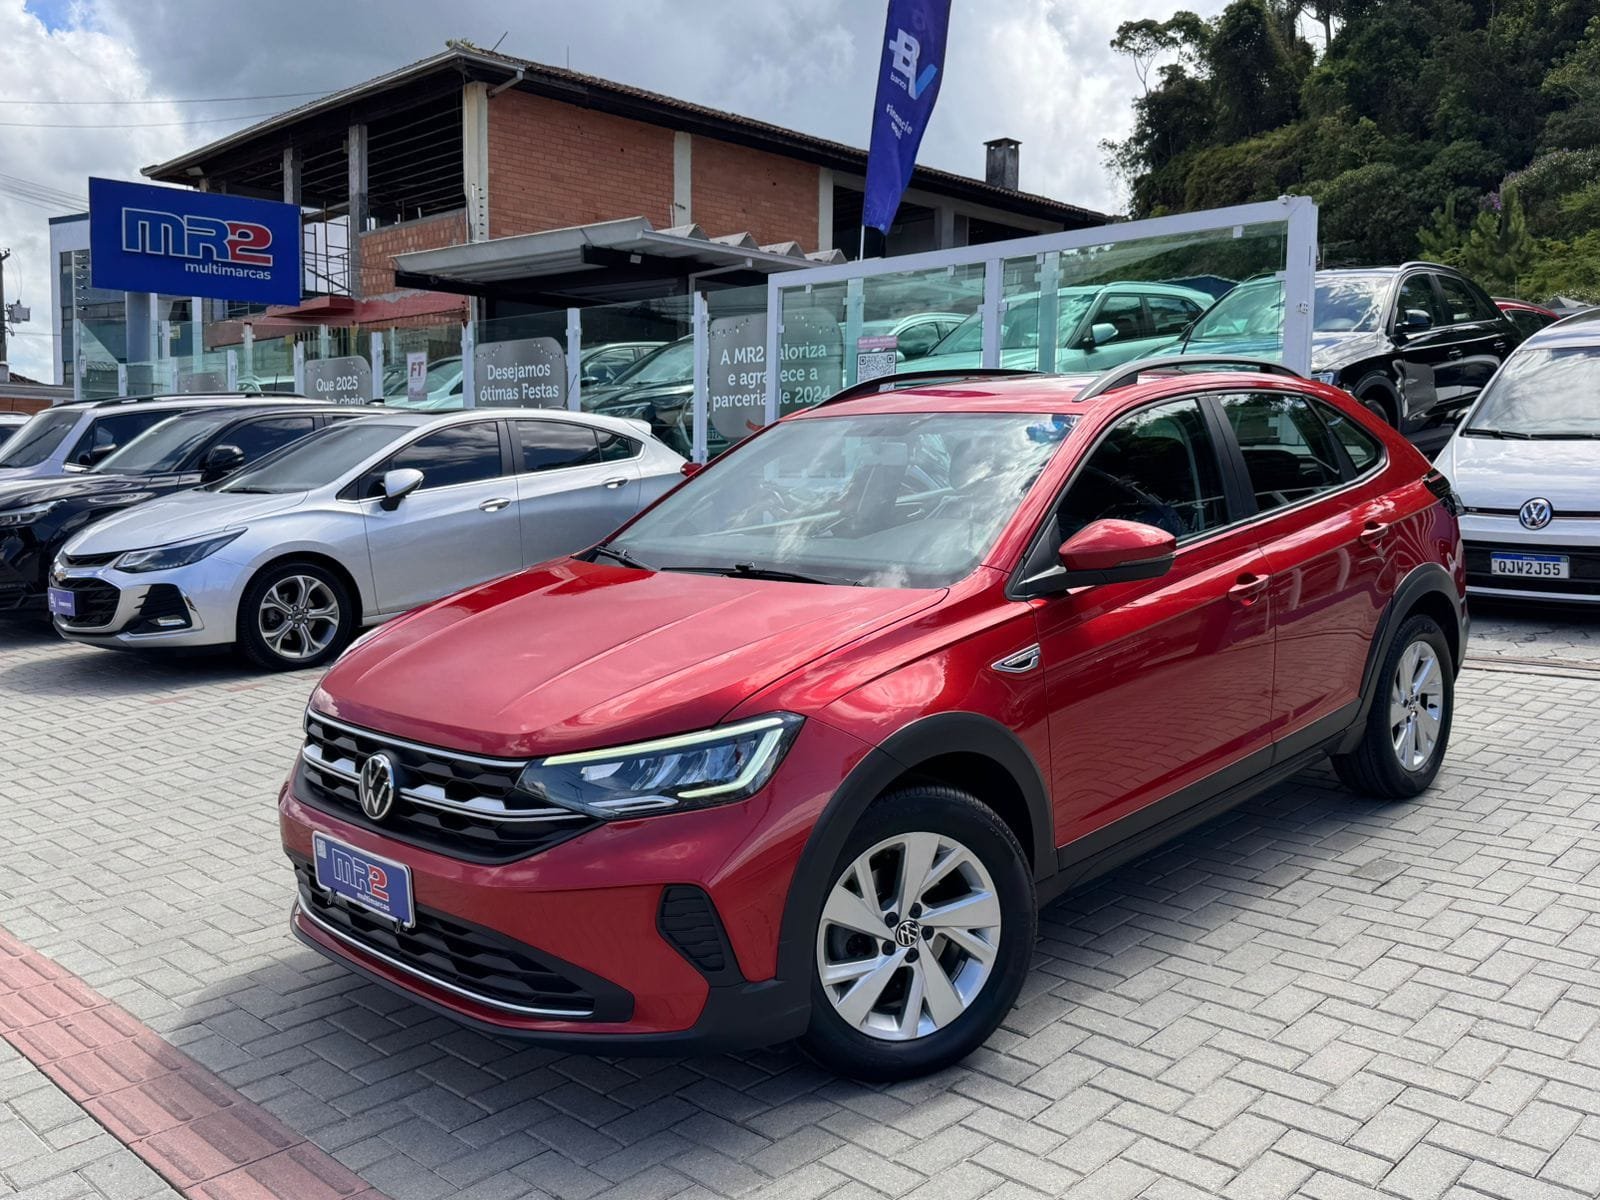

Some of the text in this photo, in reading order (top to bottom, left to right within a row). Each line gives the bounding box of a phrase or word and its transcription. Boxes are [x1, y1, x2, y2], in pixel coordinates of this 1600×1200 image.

[185, 262, 272, 281] multimarcas
[720, 342, 828, 366] A MR2 aloriza
[410, 361, 425, 377] FT
[487, 362, 551, 382] Desejamos
[728, 369, 818, 389] e agraece a
[316, 375, 359, 393] Que 2025
[480, 382, 560, 402] ótimas Festas
[713, 390, 766, 412] parceria
[794, 384, 831, 405] 2024
[1498, 560, 1561, 576] QJW2J55
